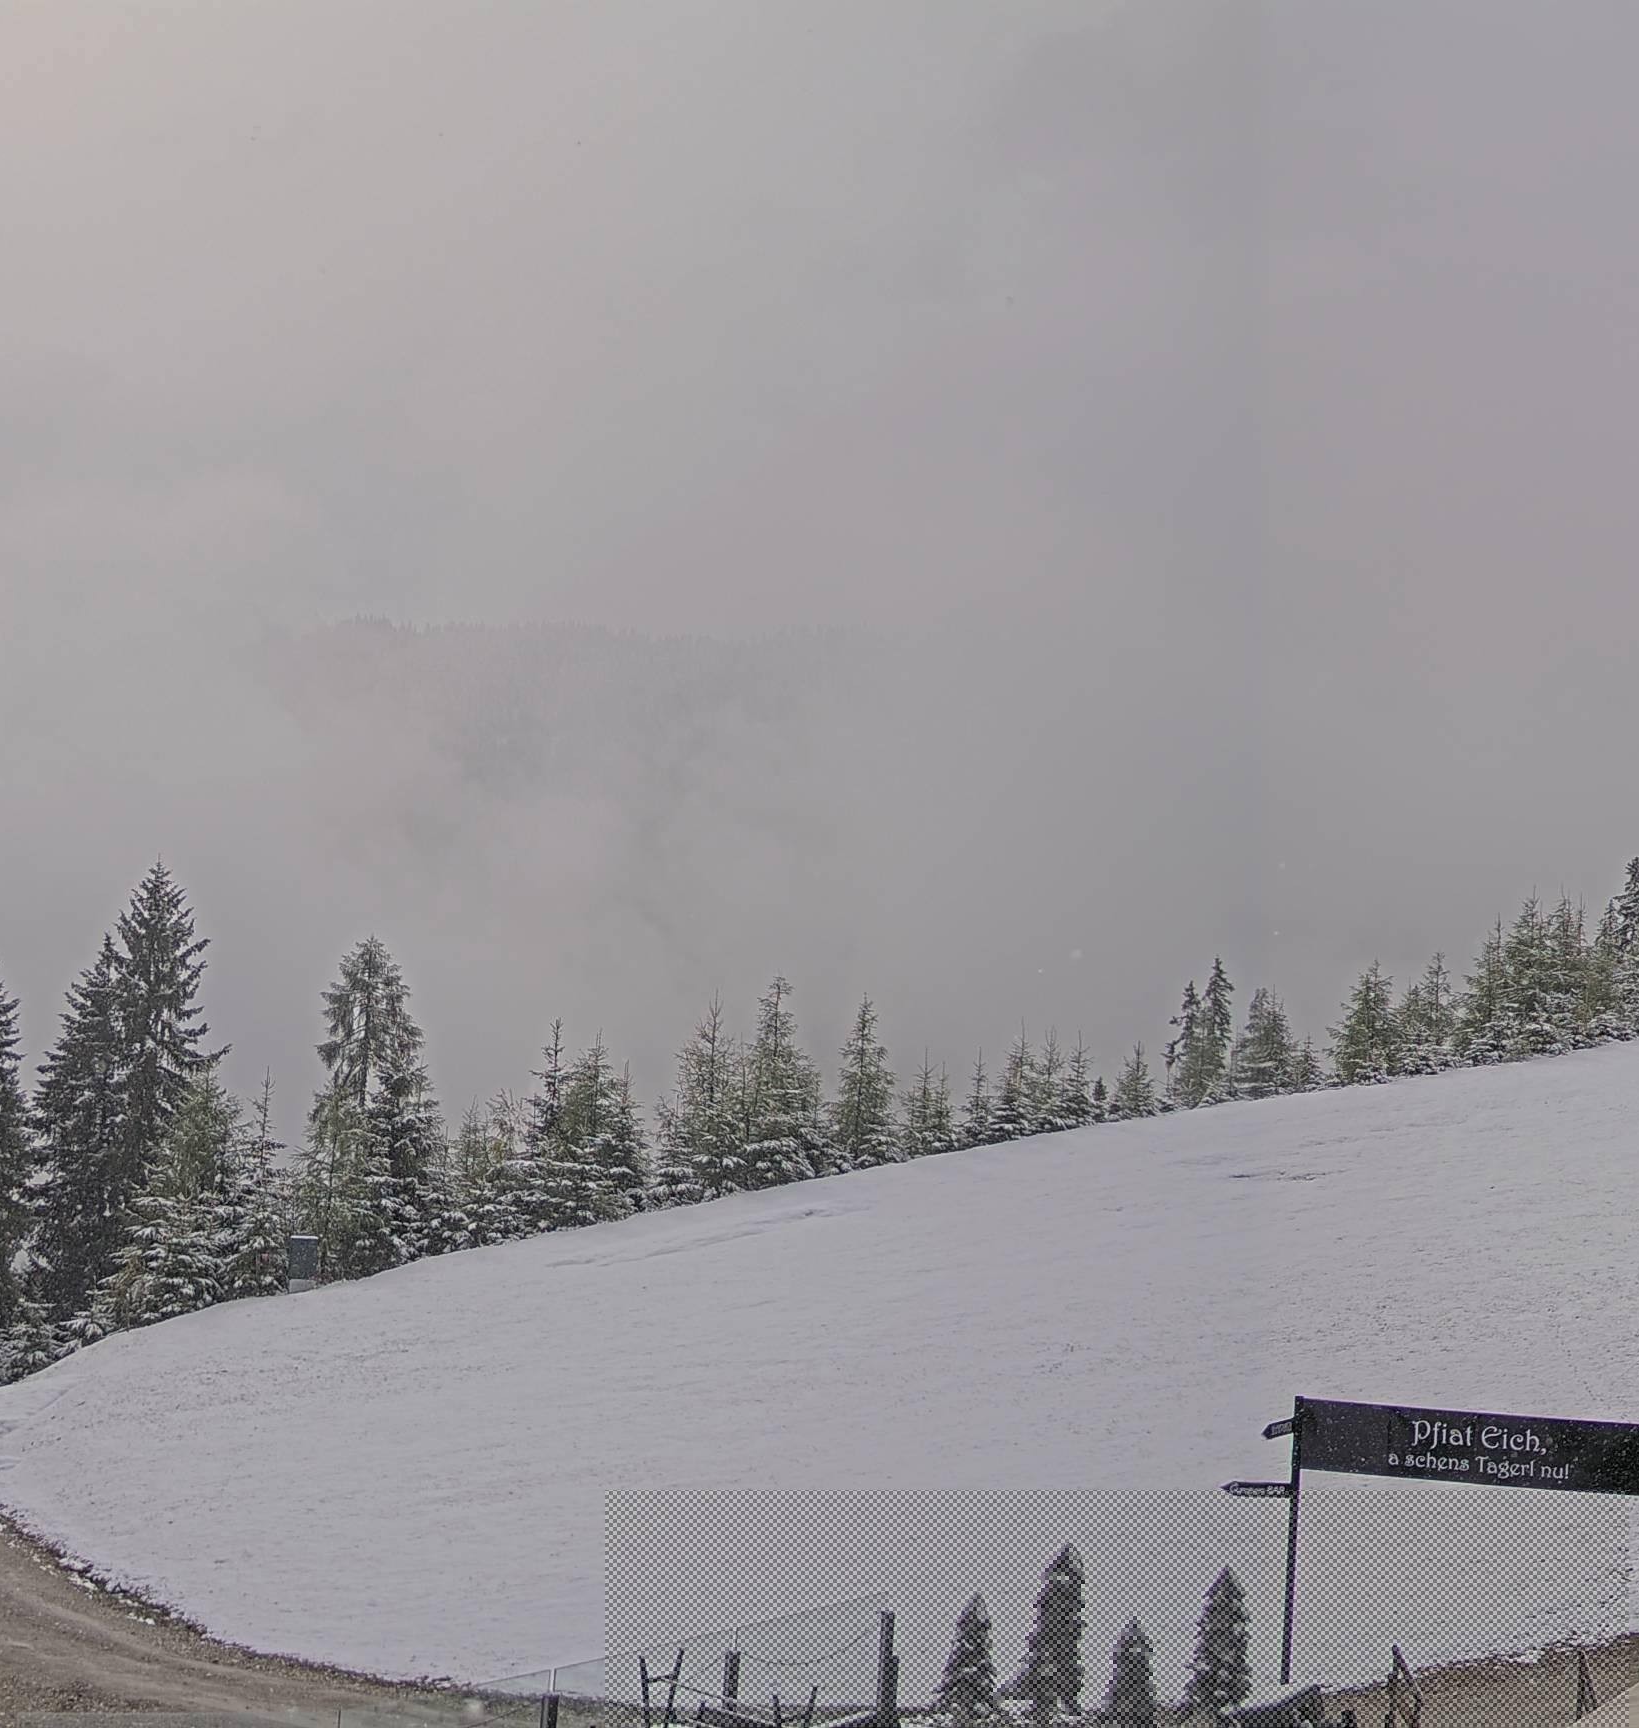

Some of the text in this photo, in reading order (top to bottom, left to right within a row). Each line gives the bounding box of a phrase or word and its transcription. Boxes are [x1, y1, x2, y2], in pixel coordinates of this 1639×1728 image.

[1411, 1420, 1547, 1455] Pfiat Eich,
[1388, 1452, 1570, 1479] a schens Tagerl nu!
